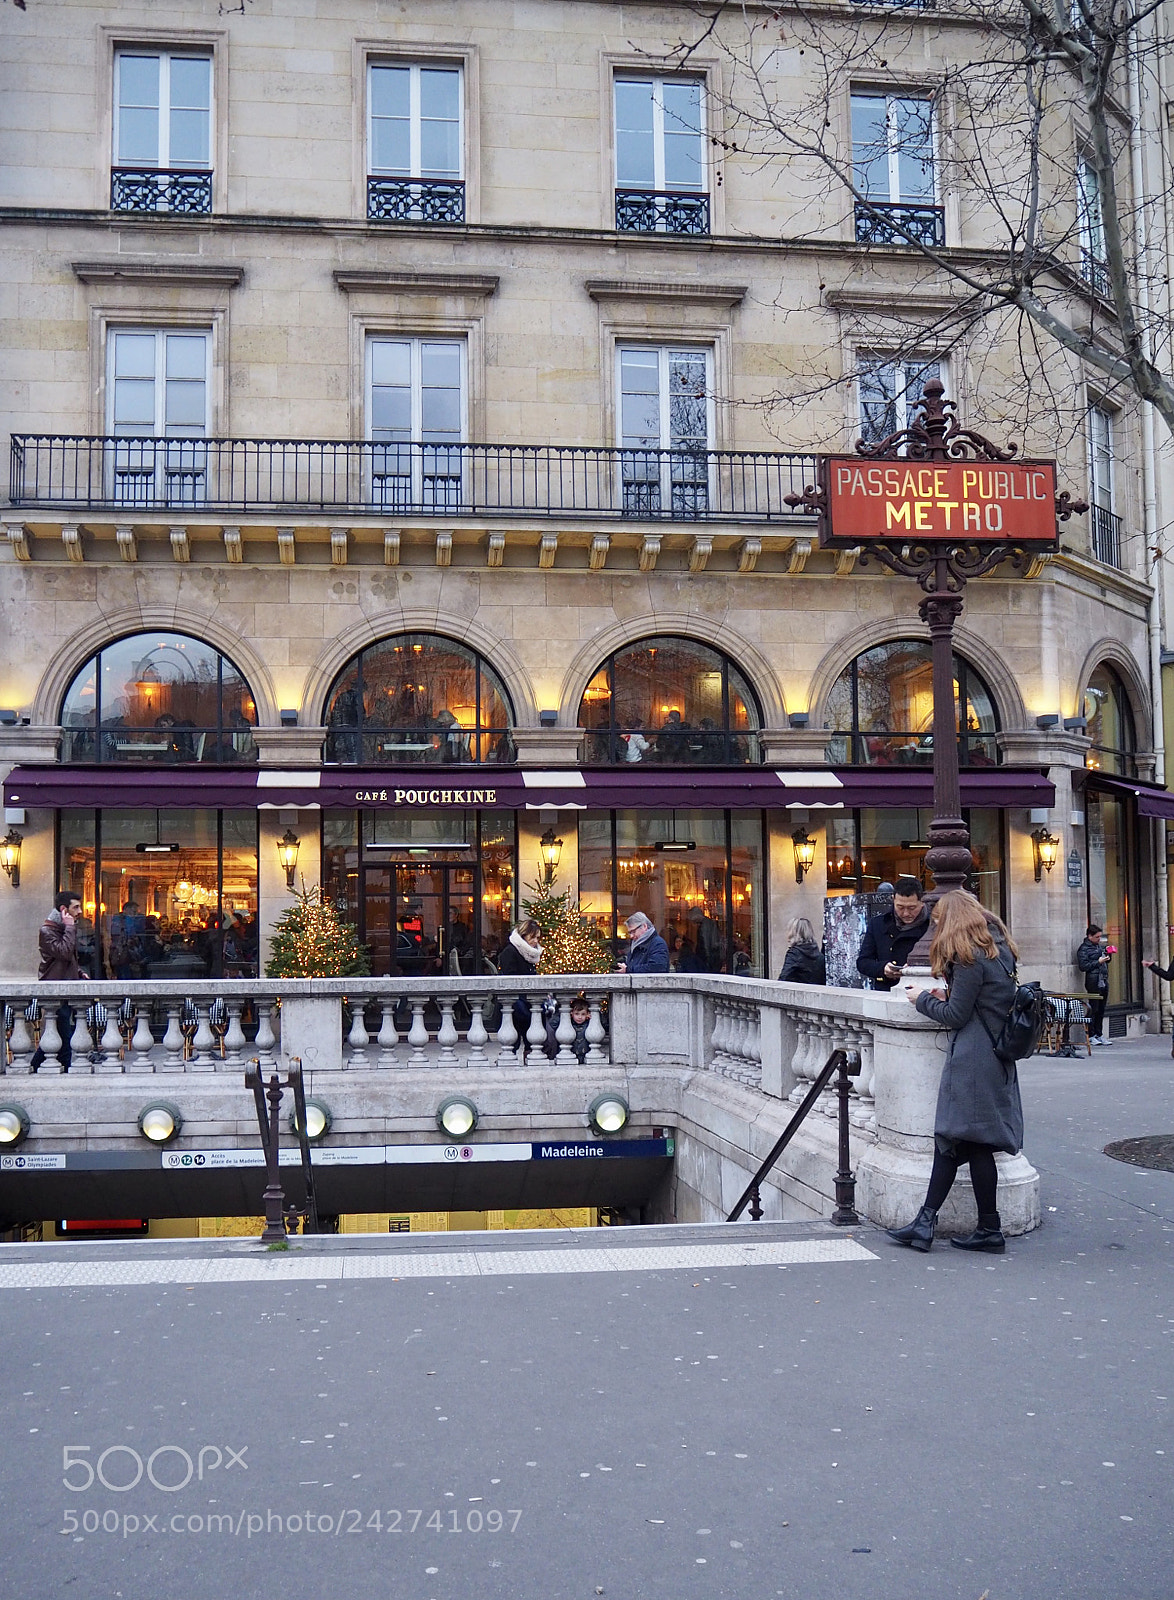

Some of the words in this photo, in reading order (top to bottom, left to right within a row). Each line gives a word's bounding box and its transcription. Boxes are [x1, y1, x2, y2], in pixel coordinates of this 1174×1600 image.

[837, 468, 950, 498] PASSAGE
[963, 470, 1046, 500] PUBLIC
[886, 501, 1003, 531] METRO
[355, 790, 388, 801] CAFÉ
[394, 789, 497, 804] POUCHKINE
[541, 1146, 604, 1158] Madeleine
